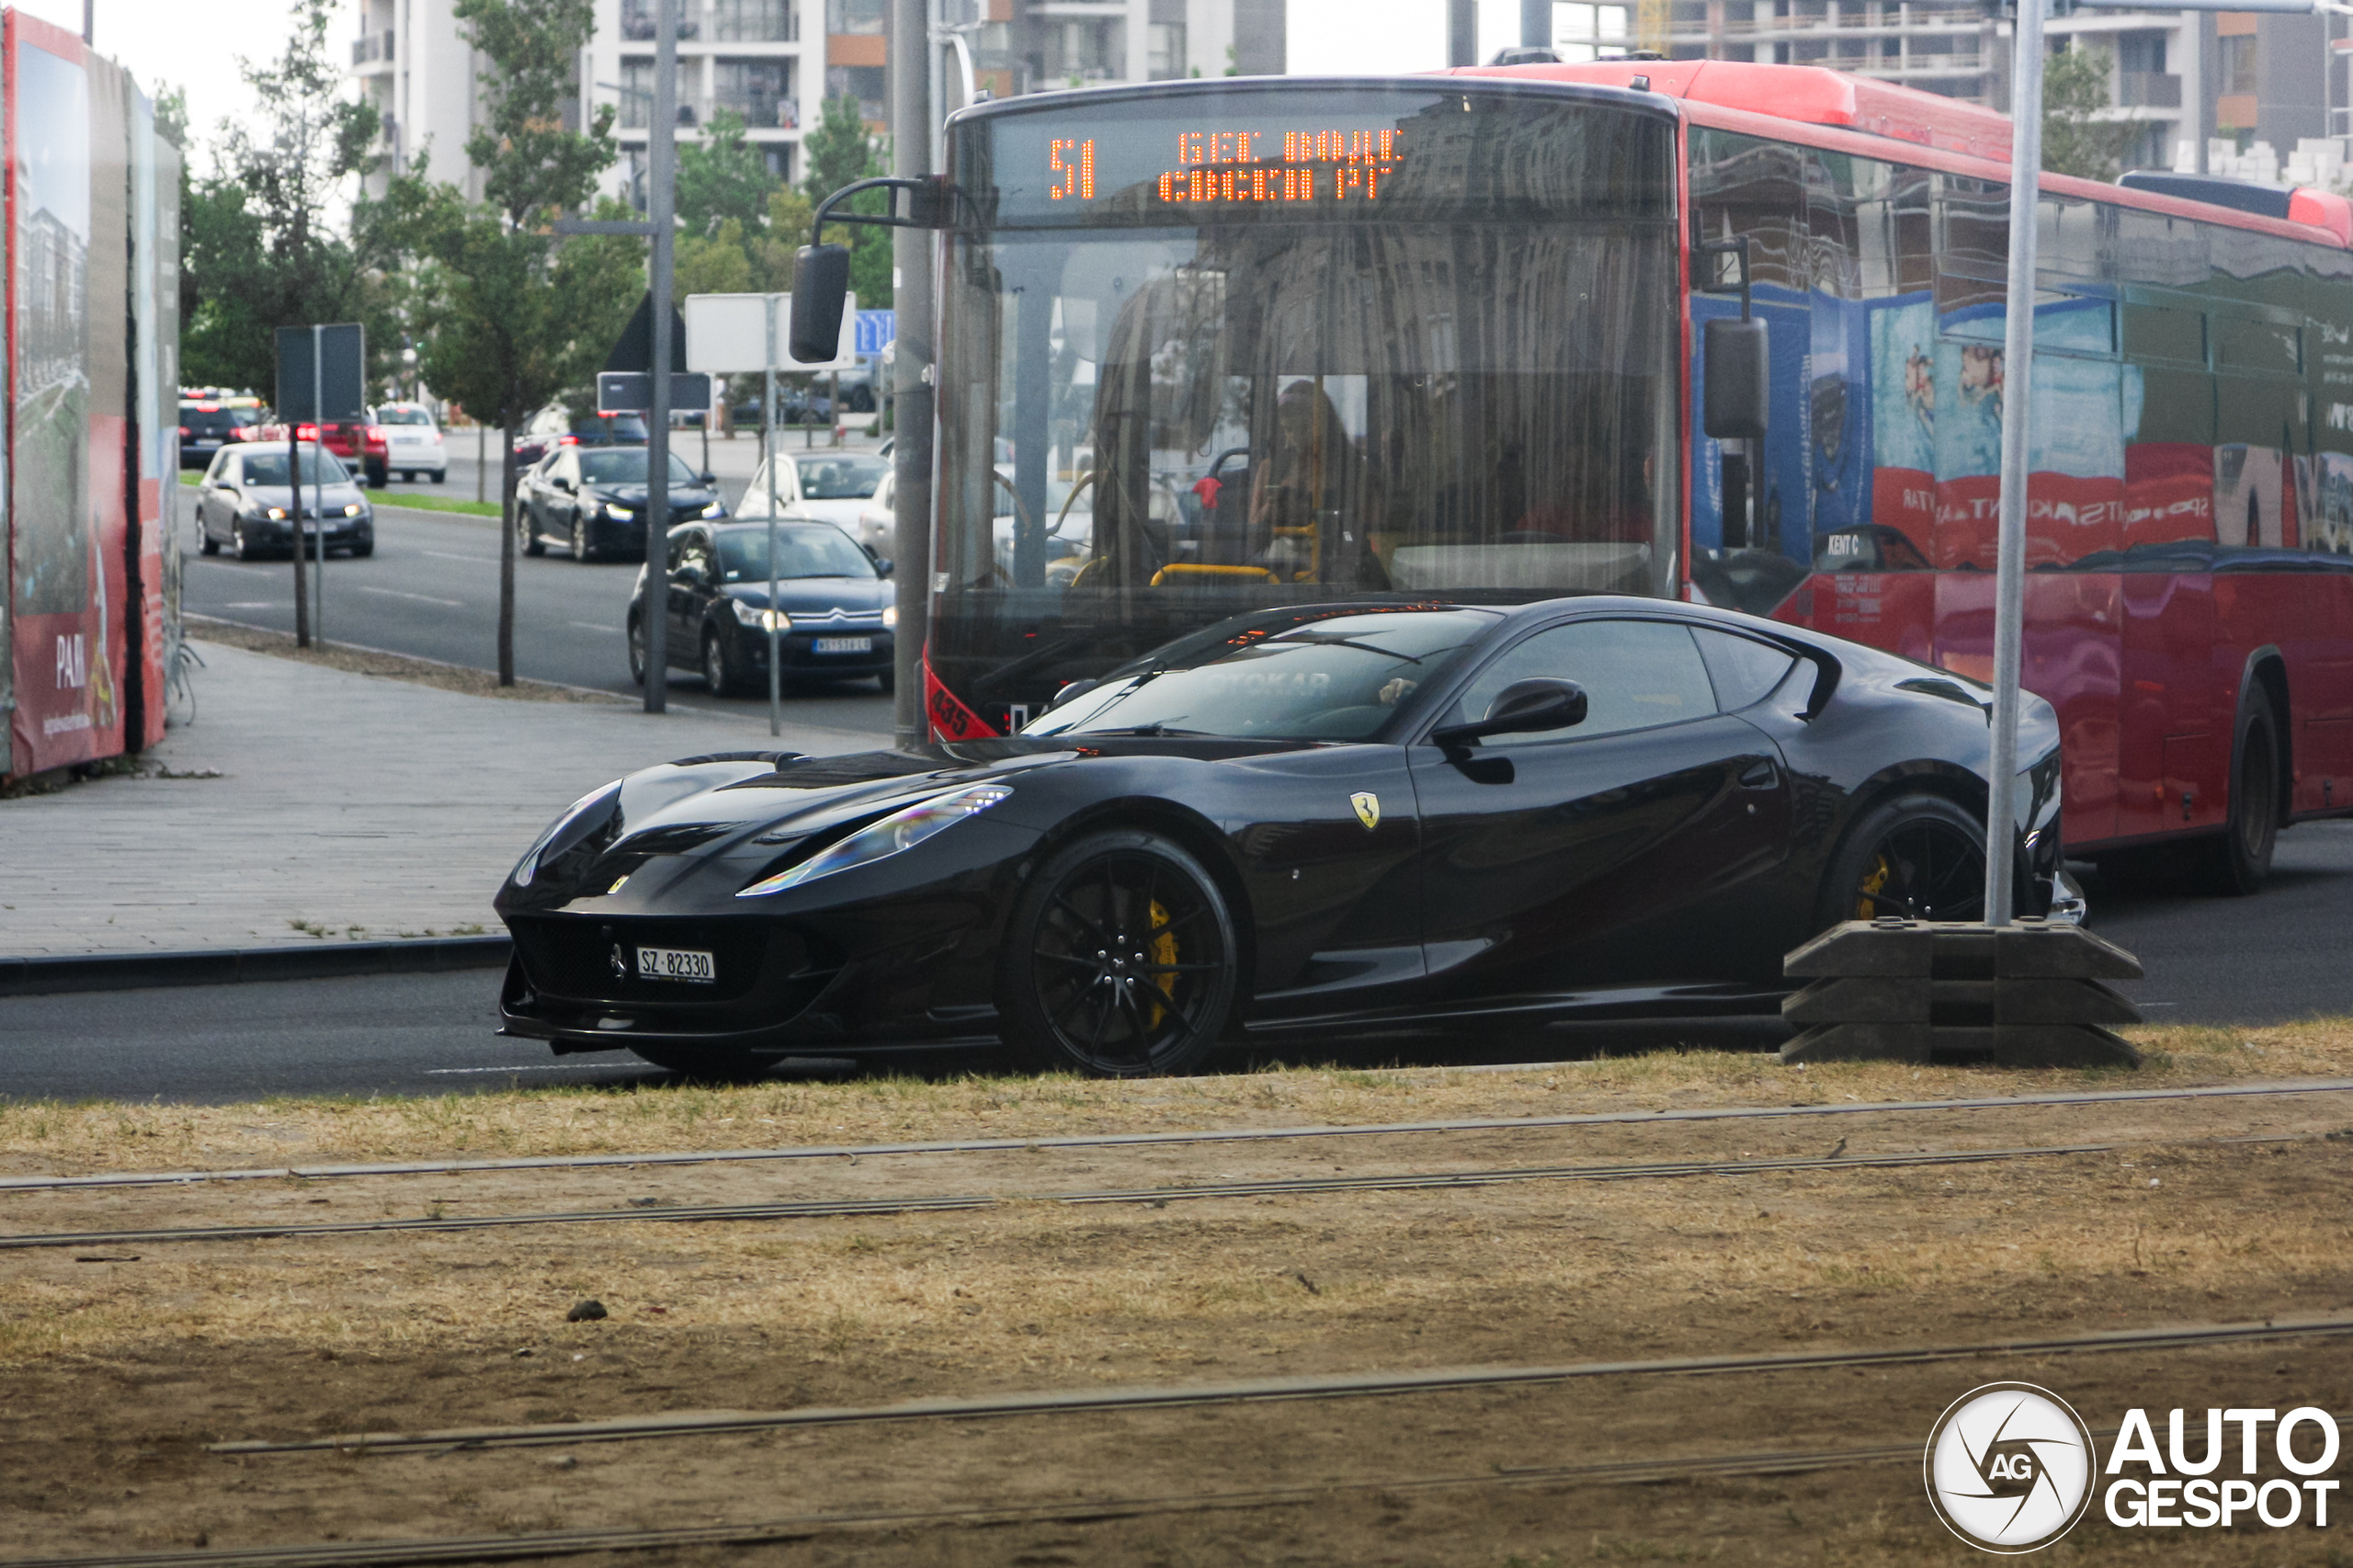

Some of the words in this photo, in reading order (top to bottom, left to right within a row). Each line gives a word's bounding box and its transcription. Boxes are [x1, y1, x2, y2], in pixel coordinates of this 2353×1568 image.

[1051, 139, 1094, 199] 51
[1828, 534, 1851, 555] KENT
[1852, 534, 1859, 555] C
[932, 689, 969, 735] 435
[642, 950, 659, 973] SZ
[666, 952, 709, 976] 82330
